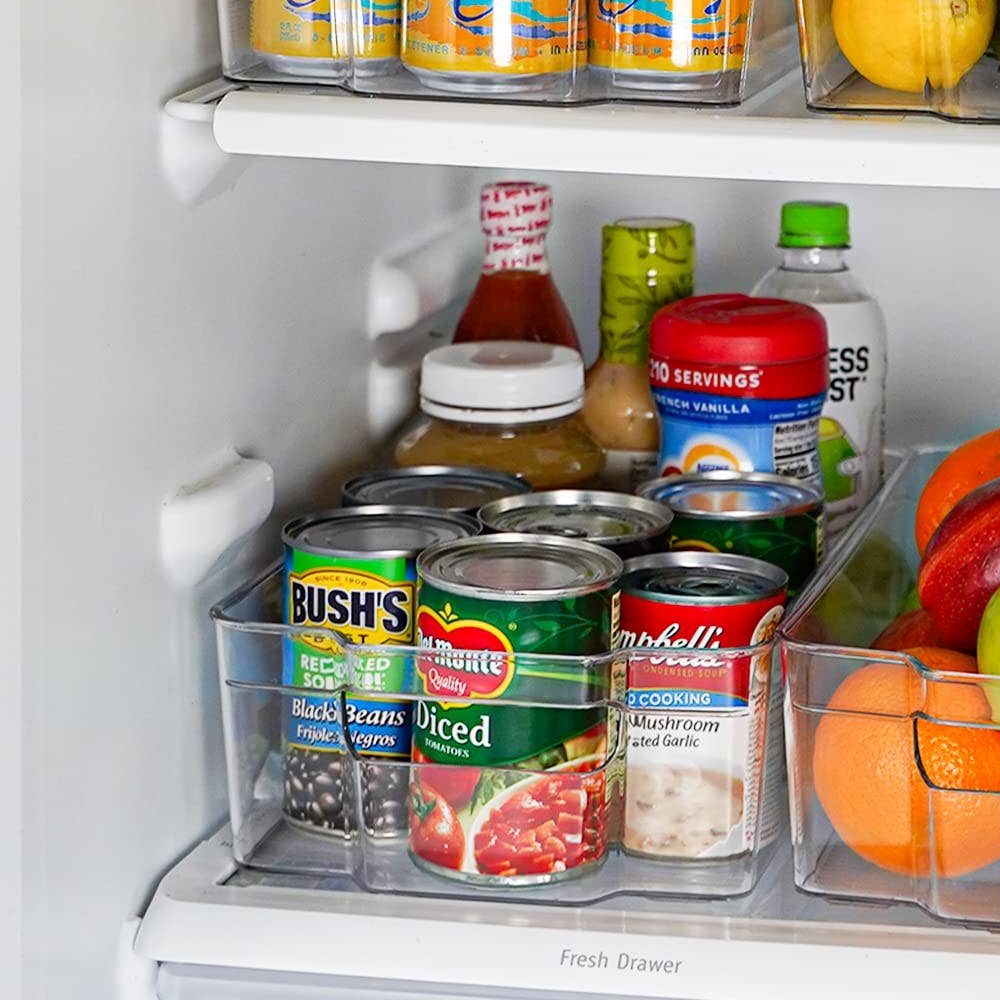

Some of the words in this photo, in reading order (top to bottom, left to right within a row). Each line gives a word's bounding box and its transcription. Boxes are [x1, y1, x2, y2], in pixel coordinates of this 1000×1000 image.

[674, 368, 761, 388] SERVINGS
[693, 401, 751, 414] VANILLA
[291, 581, 409, 634] BUSH'S
[428, 667, 467, 697] Quality
[639, 692, 711, 706] COOKING
[345, 703, 406, 727] Beans
[416, 699, 492, 748] Diced
[296, 724, 340, 744] Frijole
[662, 733, 701, 748] Garlic
[424, 736, 470, 759] TOMATOES
[560, 948, 610, 970] Fresh
[616, 952, 684, 974] Drawer
